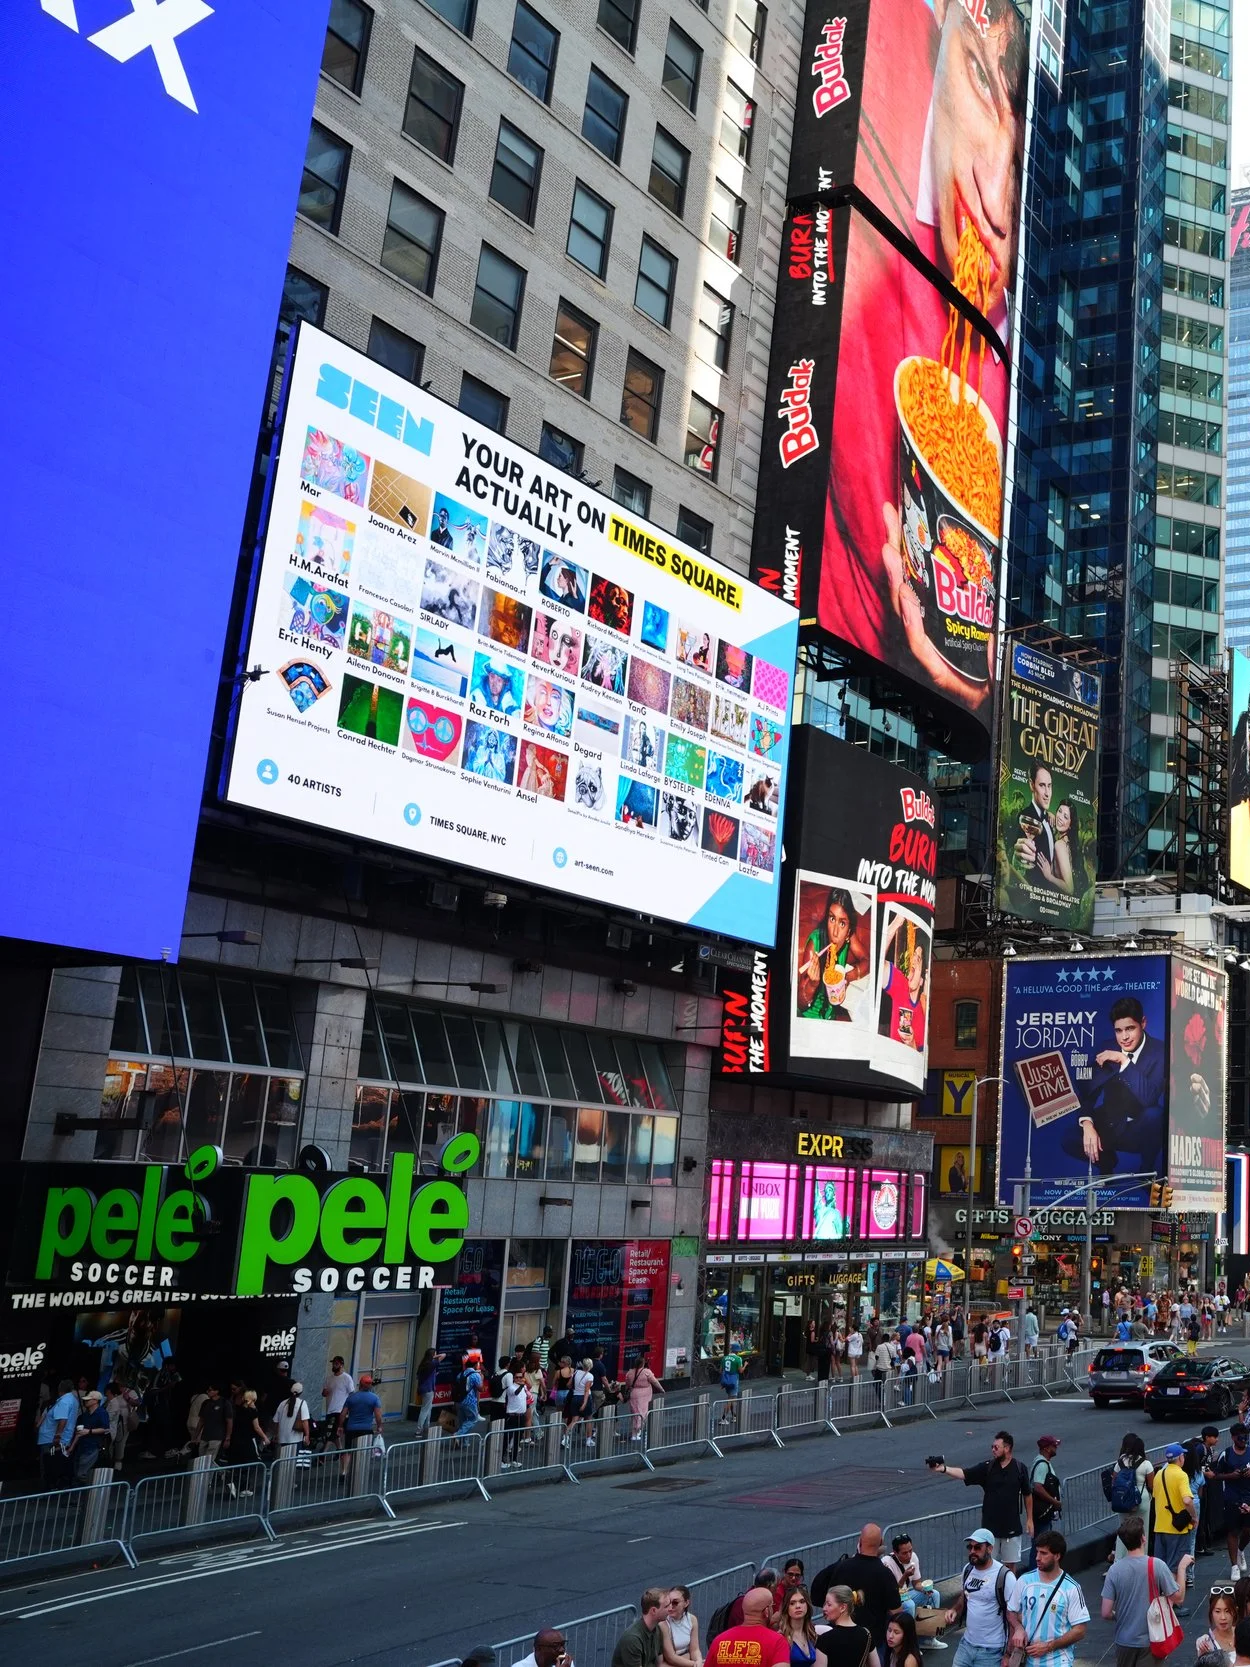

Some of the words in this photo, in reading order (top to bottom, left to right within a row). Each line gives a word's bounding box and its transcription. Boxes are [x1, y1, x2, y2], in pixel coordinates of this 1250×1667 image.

[812, 16, 851, 118] Buldak
[814, 238, 828, 269] THE
[812, 271, 827, 305] INTO
[316, 363, 435, 457] SEEN
[778, 358, 819, 469] Buldak
[300, 480, 321, 498] Mar
[455, 466, 575, 547] ACTUALLY.
[368, 514, 395, 535] Joana
[397, 529, 417, 545] Arez
[461, 431, 524, 488] YOUR
[529, 475, 572, 514] ART
[577, 500, 606, 534] ON
[612, 517, 666, 566] TIMES
[670, 552, 740, 608] SQUARE.
[289, 553, 349, 589] H.M.Arafat
[783, 524, 800, 600] MOMENT
[358, 584, 389, 603] Francesco
[486, 571, 527, 597] Fabianaa.rt
[541, 598, 571, 617] ROBERTO
[419, 612, 449, 630] SIRLADY
[945, 618, 970, 639] Spicy
[278, 627, 299, 645] Eric
[301, 636, 333, 659] Henty
[346, 656, 370, 673] Aileen
[372, 667, 405, 686] Donovan
[531, 660, 576, 686] 4everKurious
[1017, 656, 1039, 671] CORBIN
[1040, 666, 1055, 678] BLEU
[580, 681, 601, 698] Audrey
[469, 702, 487, 719] Raz
[488, 710, 510, 727] Forh
[627, 701, 647, 716] YanG
[266, 707, 286, 718] Susan
[286, 713, 306, 726] Hensel
[308, 720, 331, 734] Projects
[670, 719, 686, 733] Emily
[687, 726, 707, 741] Joseph
[1012, 694, 1041, 729] THE
[1044, 708, 1098, 751] GREAT
[336, 729, 366, 746] Conrad
[367, 739, 396, 756] Hechter
[523, 724, 545, 739] Regina
[545, 732, 569, 747] Affonso
[401, 752, 425, 766] Dagmar
[573, 742, 603, 761] Degard
[1020, 728, 1087, 773] GATSBY
[620, 761, 638, 774] Linda
[638, 768, 661, 783] Laforge
[287, 773, 300, 785] 40
[302, 778, 342, 797] ARTISTS
[460, 772, 482, 786] Sophie
[483, 780, 511, 795] Venturini
[664, 777, 695, 796] BYSTELPE
[516, 789, 538, 804] Ansel
[430, 815, 454, 831] TIMES
[455, 823, 490, 842] SQUARE,
[491, 834, 507, 846] NYC
[889, 823, 937, 877] BURN
[574, 859, 614, 876] art-seen.com
[857, 858, 892, 890] INTO
[896, 869, 918, 897] THE
[1023, 986, 1054, 994] HELLUVA
[1055, 984, 1082, 993] GOOD
[1084, 984, 1101, 992] TIME
[1016, 1011, 1098, 1025] JEREMY
[1015, 1026, 1095, 1049] JORDAN
[1070, 1053, 1089, 1067] BOBBY
[1027, 1061, 1054, 1086] JUST
[1075, 1067, 1093, 1080] DARIN
[945, 1080, 973, 1113] Y
[742, 1182, 781, 1196] UNBOX
[35, 1145, 223, 1280] pelé
[234, 1132, 480, 1296] pelé
[955, 1209, 1009, 1224] GFTS
[1033, 1211, 1115, 1226] UGGAGE
[629, 1258, 664, 1267] Restaurant
[630, 1249, 651, 1259] Retail/
[71, 1262, 176, 1287] SOCCER
[292, 1266, 436, 1292] SOCCER
[628, 1268, 646, 1276] Space
[648, 1267, 658, 1275] for
[628, 1276, 647, 1284] Lease
[787, 1275, 815, 1287] GIFTS
[829, 1274, 862, 1285] LUGGAGE
[11, 1293, 45, 1309] THE
[49, 1289, 120, 1307] WORLD'S
[443, 1296, 480, 1305] Restaurant
[444, 1287, 467, 1296] Retail/
[442, 1306, 459, 1314] Space
[461, 1305, 471, 1313] for
[473, 1304, 494, 1313] Lease
[260, 1326, 296, 1352] pelé
[3, 1364, 38, 1373] SOCCER
[968, 1578, 985, 1588] NIKE
[1023, 1596, 1037, 1611] 19
